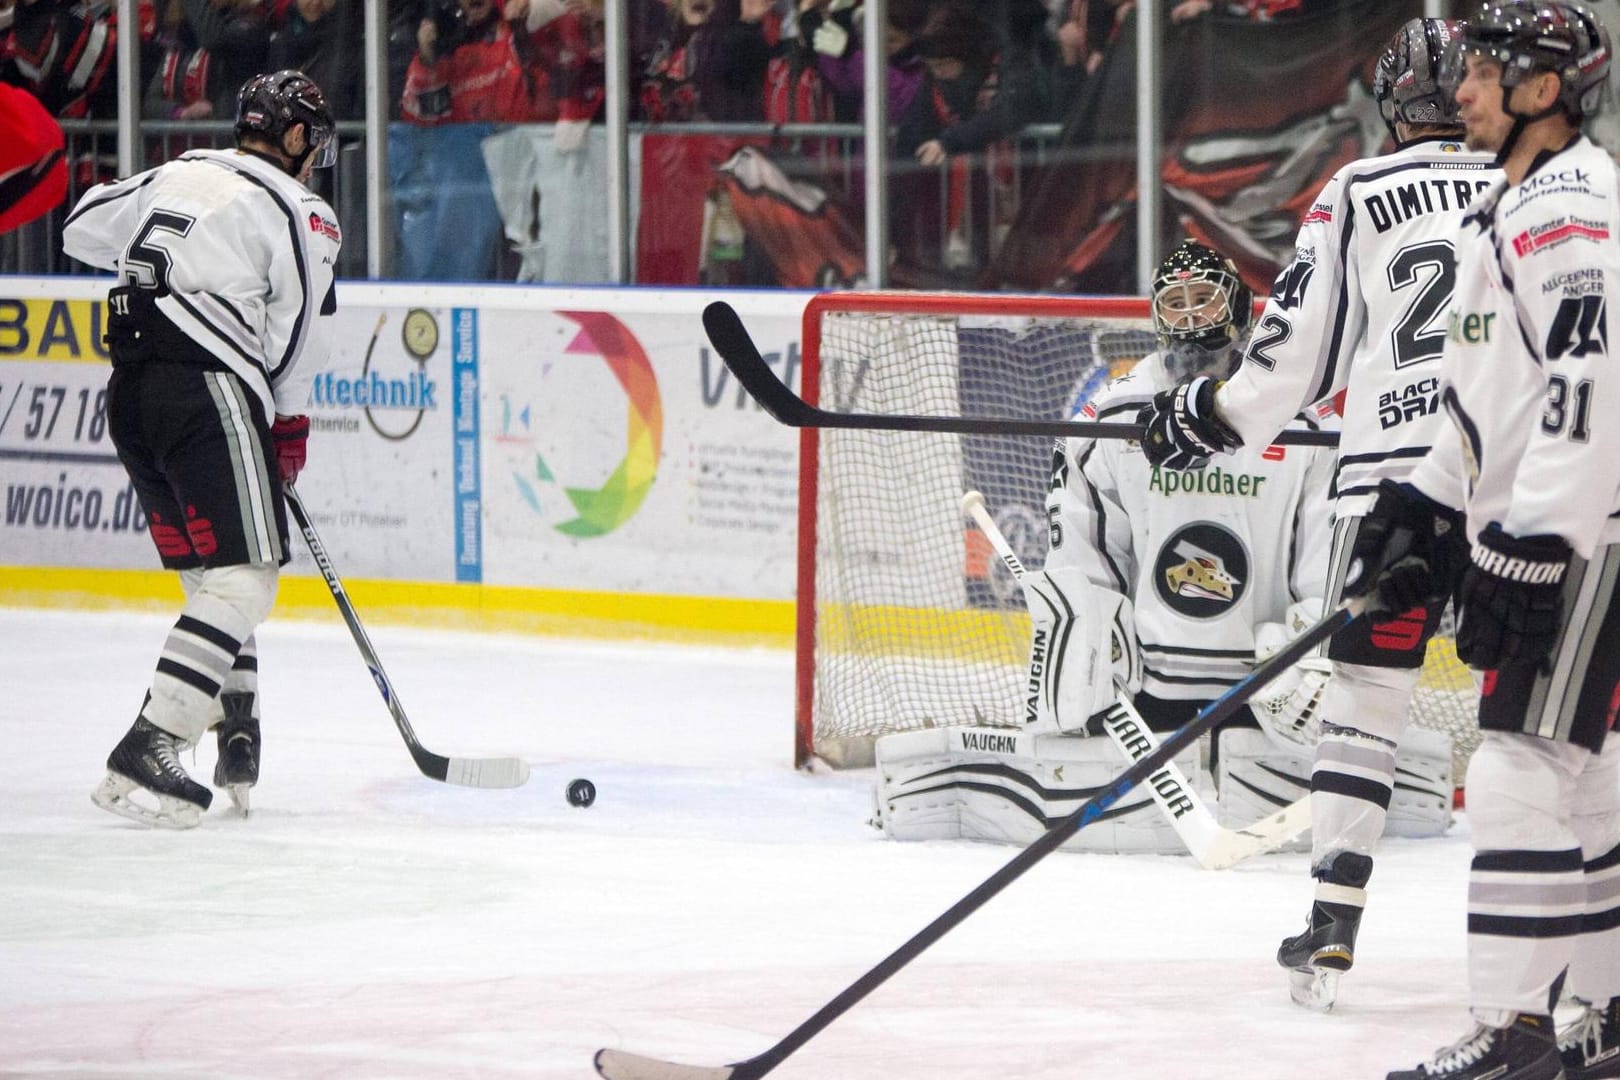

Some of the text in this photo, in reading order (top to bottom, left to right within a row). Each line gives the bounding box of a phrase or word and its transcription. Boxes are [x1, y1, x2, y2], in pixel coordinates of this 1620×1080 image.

[126, 208, 197, 297] 5
[1387, 239, 1457, 371] 2
[456, 308, 473, 363] Service
[1246, 312, 1293, 372] 2
[25, 386, 66, 440] 57
[1541, 373, 1595, 444] 31
[1150, 464, 1266, 497] Apoldaer
[1026, 629, 1047, 724] VAUGHN
[961, 732, 1017, 754] VAUGHN
